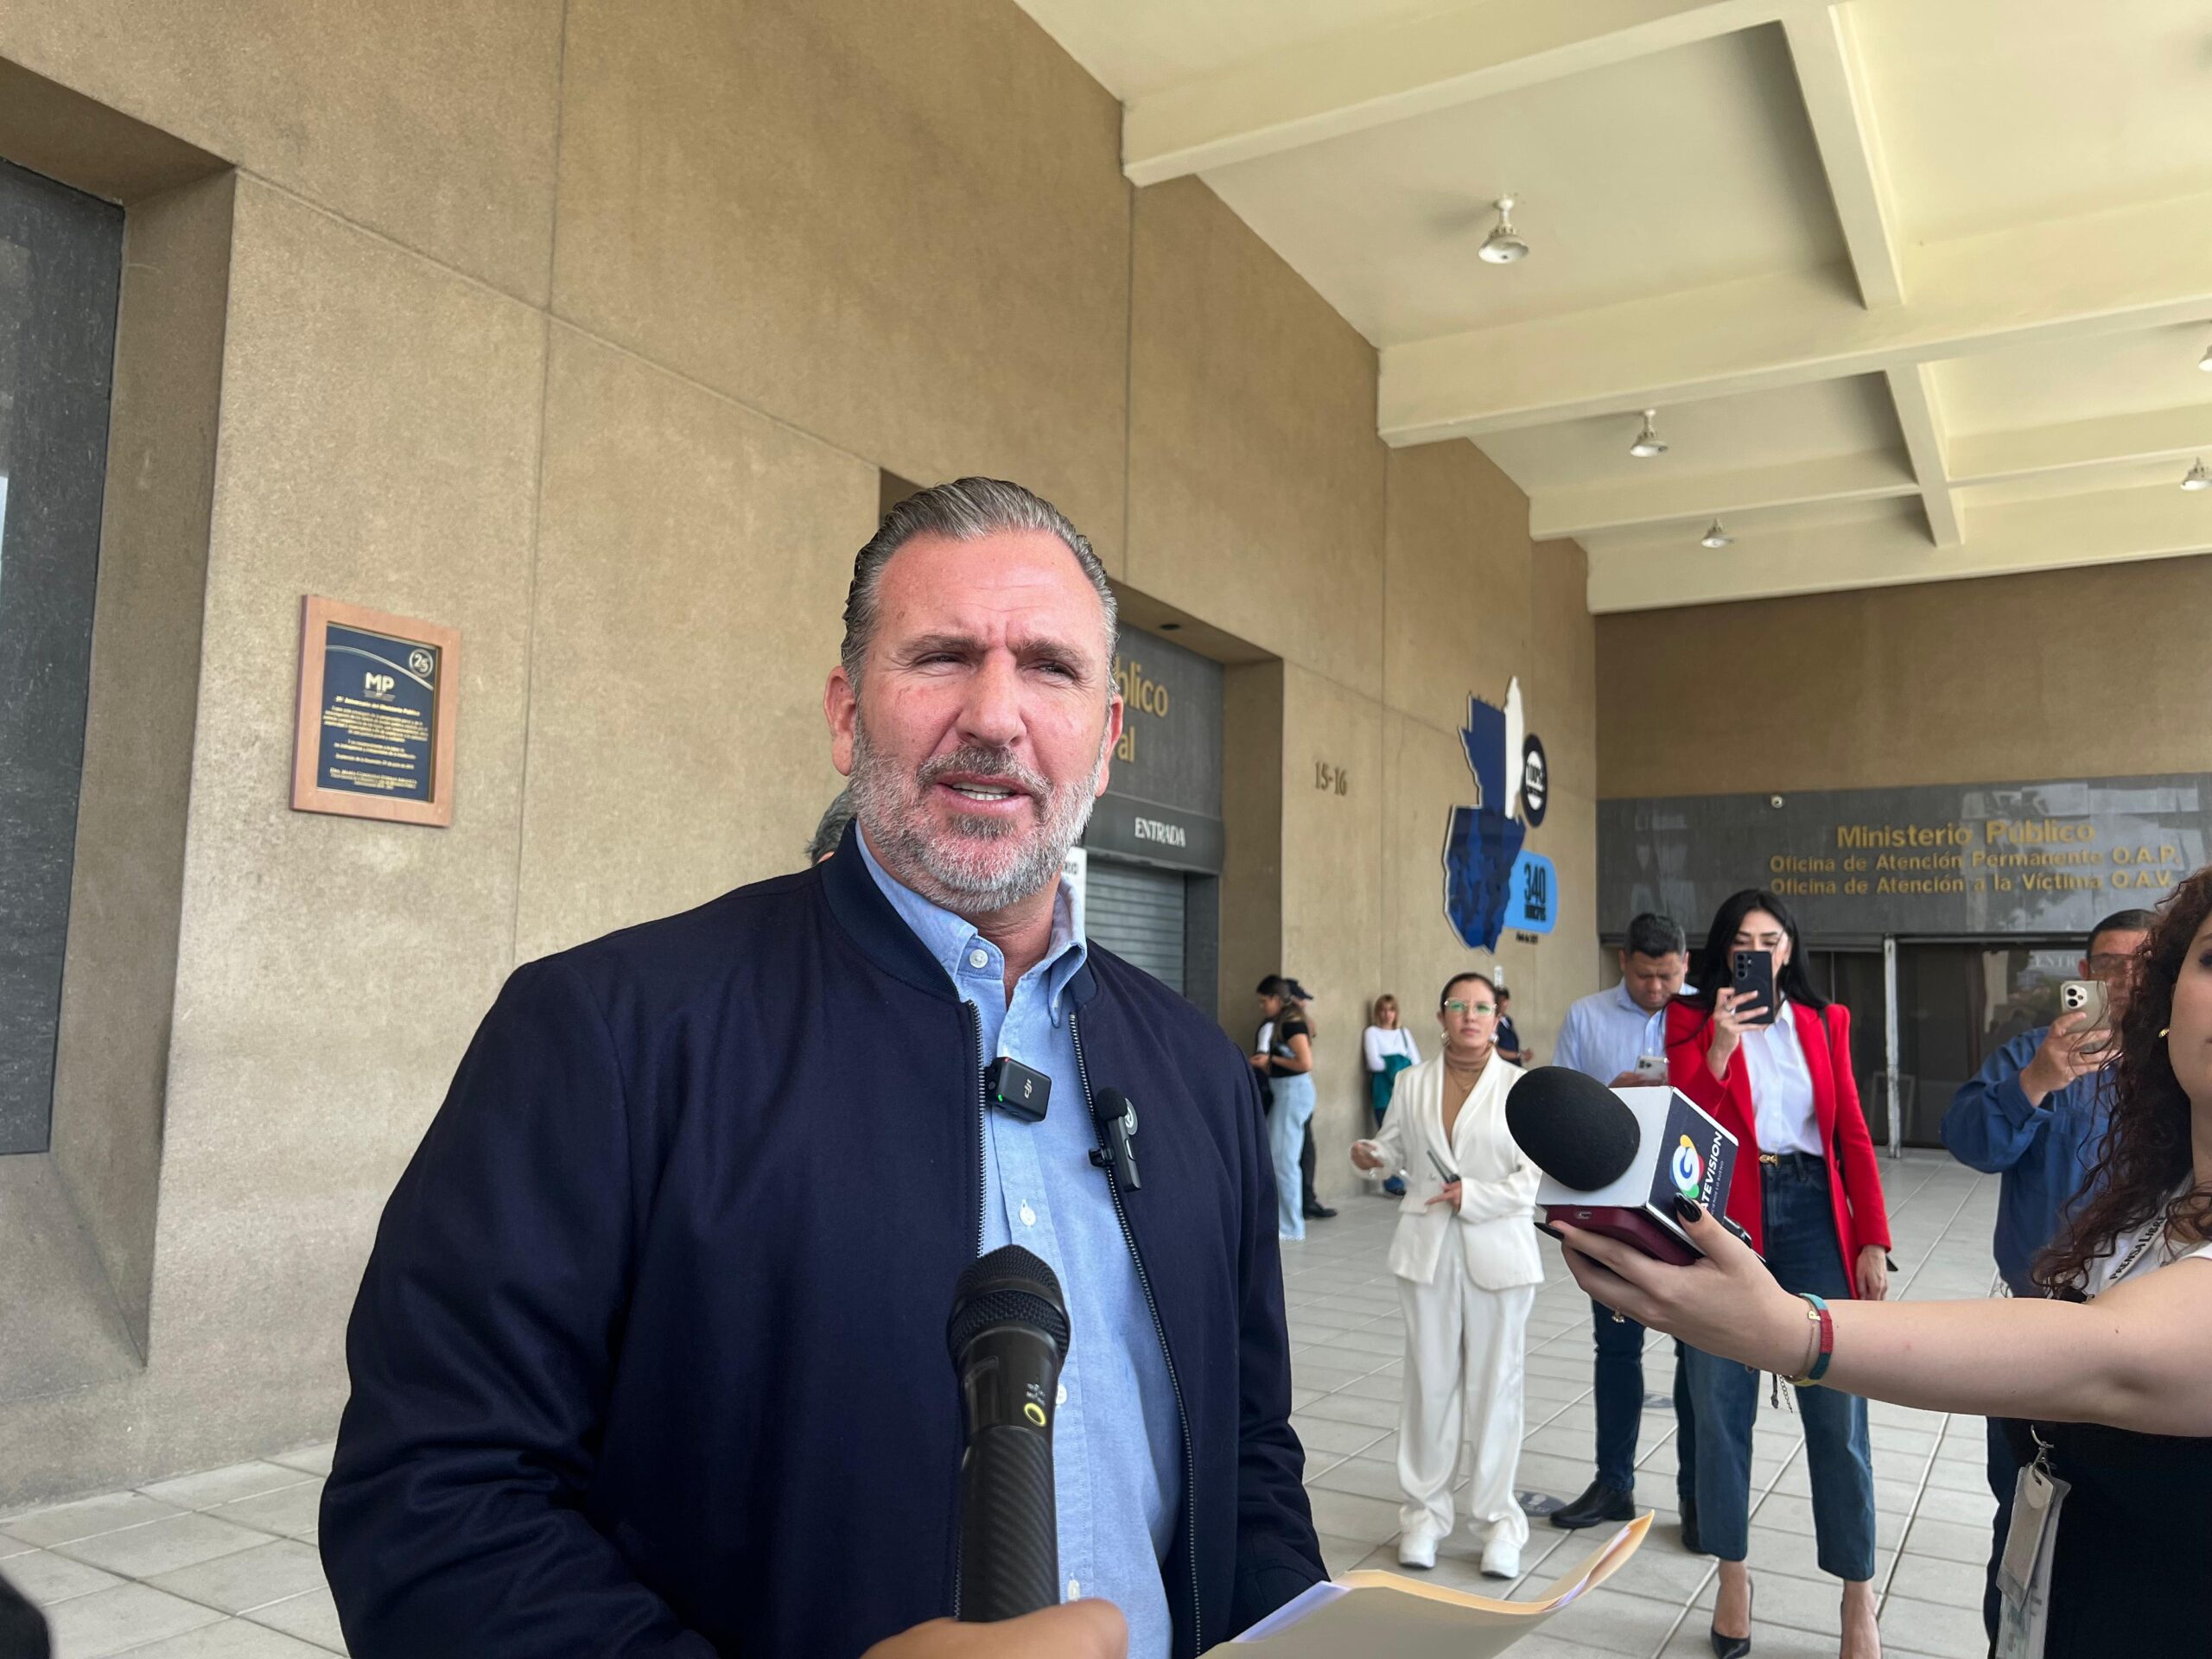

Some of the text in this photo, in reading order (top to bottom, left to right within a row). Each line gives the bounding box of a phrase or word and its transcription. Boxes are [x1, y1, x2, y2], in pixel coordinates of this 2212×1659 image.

[365, 671, 395, 693] MP
[1112, 658, 1170, 718] blico
[1116, 726, 1135, 763] al
[1315, 761, 1348, 796] 15-16
[1135, 817, 1186, 848] ENTRADA
[1837, 818, 2096, 849] Ministerio Público
[1770, 845, 2181, 873] Oficina de Atención Permanente O.A.P.
[1523, 861, 1546, 905] 340
[1770, 878, 1837, 895] Oficina
[1844, 876, 1868, 895] de
[1877, 874, 1964, 893] Atención
[1974, 878, 1986, 893] a
[1993, 874, 2012, 892] la
[2022, 871, 2102, 891] Víctima
[1700, 1131, 1724, 1211] ATEVISION
[2109, 1216, 2167, 1280] PRENSA LIBRE
